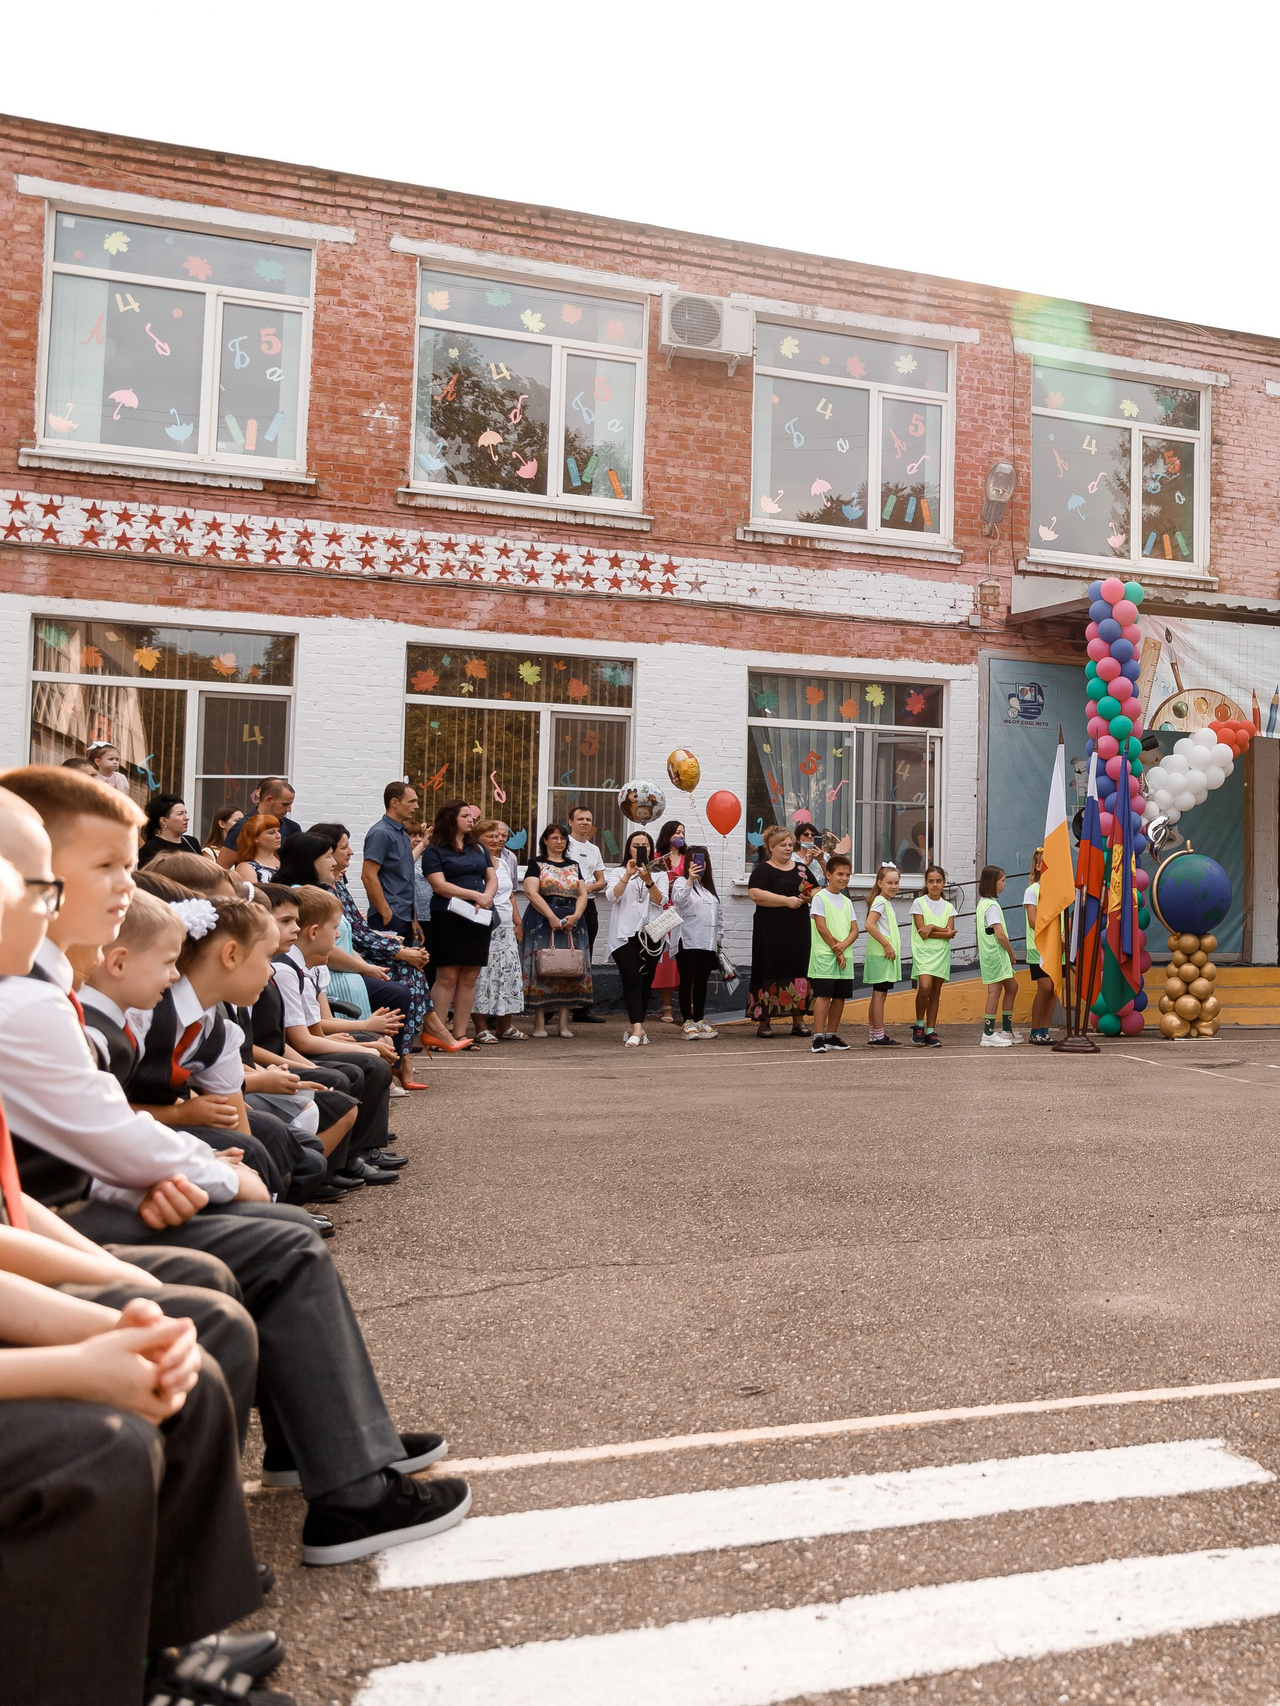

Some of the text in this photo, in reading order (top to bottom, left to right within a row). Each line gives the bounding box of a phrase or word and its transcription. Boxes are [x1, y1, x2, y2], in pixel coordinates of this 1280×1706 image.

[115, 292, 140, 313] 4
[260, 327, 282, 356] 5
[490, 362, 512, 381] 4
[594, 376, 612, 403] 5
[816, 398, 834, 420] 4
[908, 412, 926, 438] 5
[1082, 434, 1098, 455] 4
[1163, 450, 1180, 474] 5
[242, 724, 264, 746] 4
[580, 730, 600, 756] 5
[800, 750, 822, 776] 5
[894, 760, 910, 781] 4
